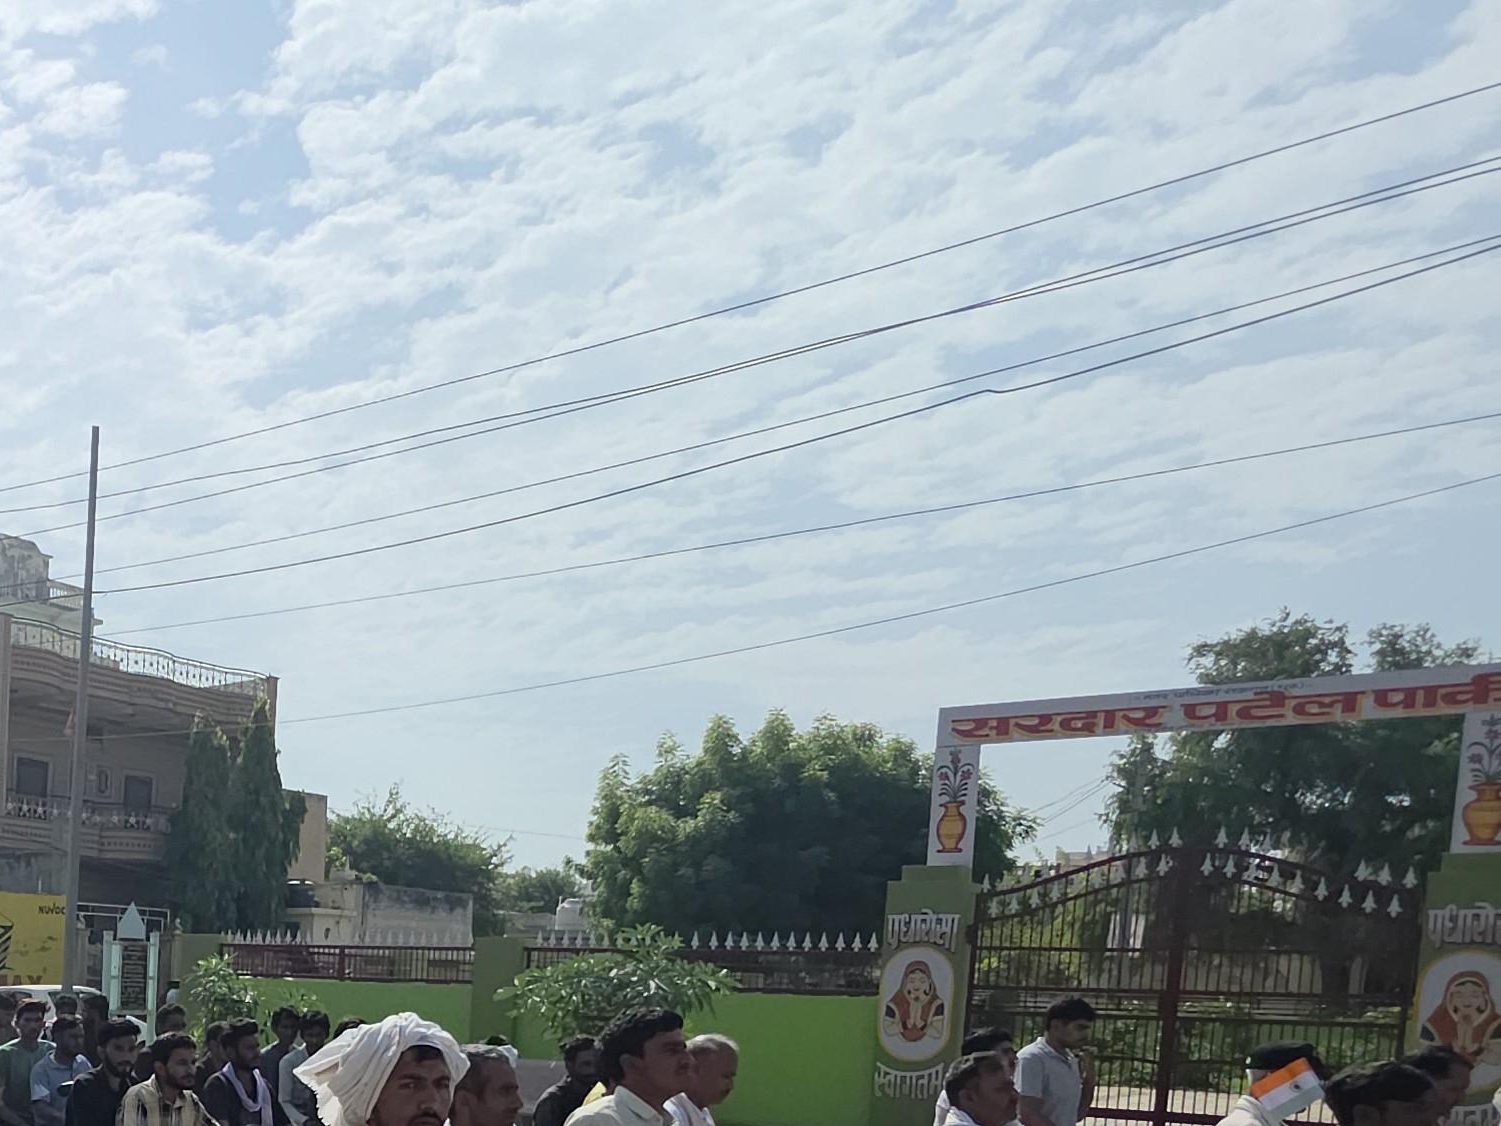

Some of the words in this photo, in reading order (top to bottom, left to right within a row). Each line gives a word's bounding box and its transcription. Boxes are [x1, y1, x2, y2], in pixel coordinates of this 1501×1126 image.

[951, 706, 1172, 739] सरदार
[1180, 689, 1367, 724] पटेल
[38, 902, 66, 915] NUVOC
